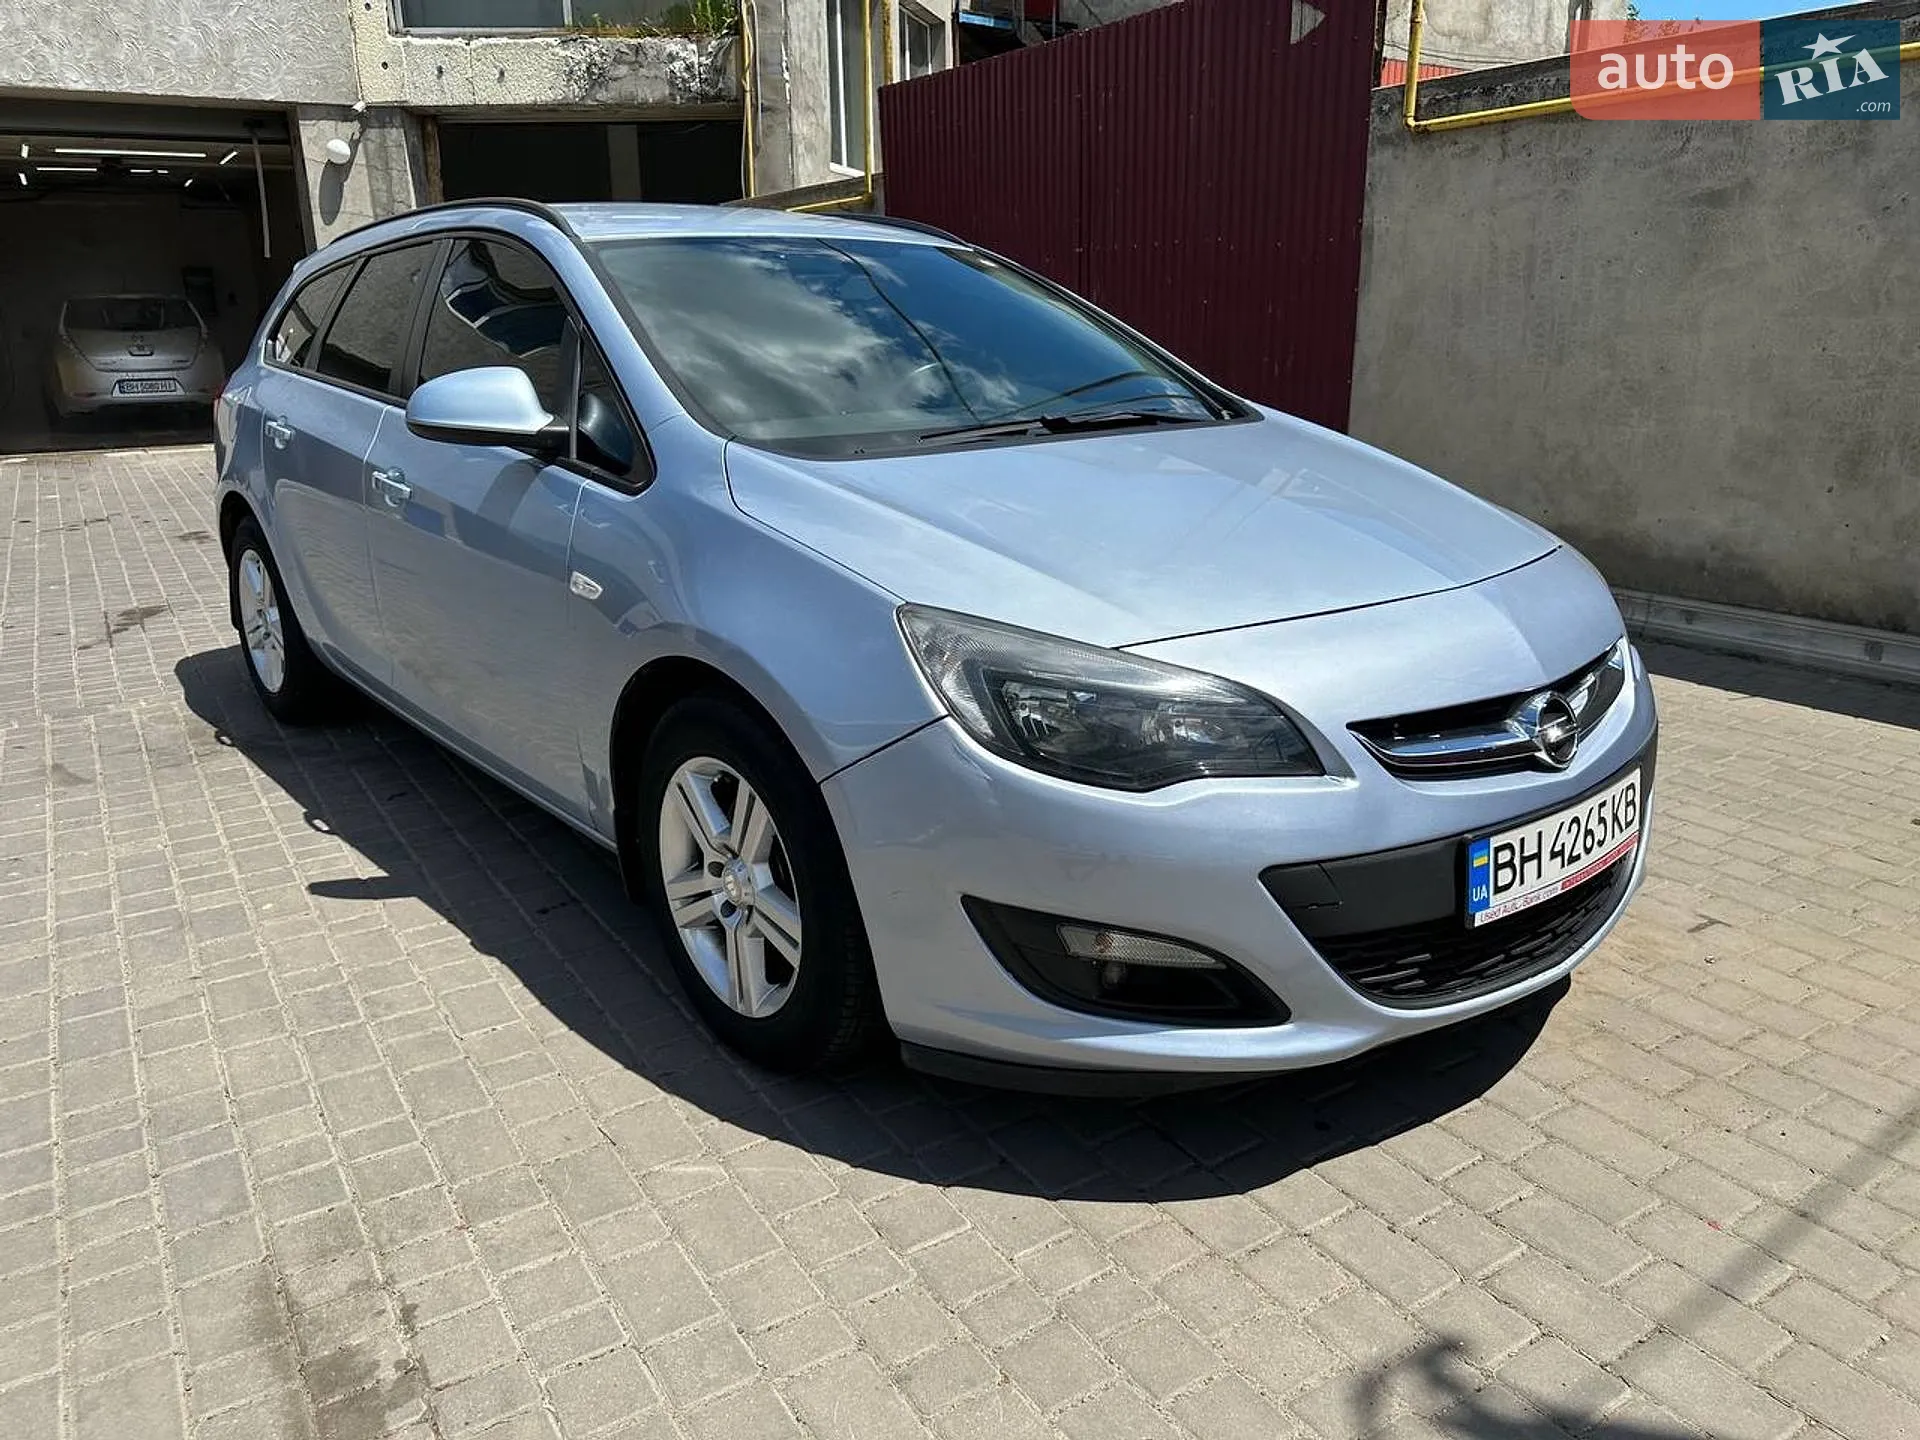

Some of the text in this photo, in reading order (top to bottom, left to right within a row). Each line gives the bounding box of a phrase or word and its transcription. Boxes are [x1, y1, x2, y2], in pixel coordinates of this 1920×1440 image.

[1493, 830, 1543, 896] BH
[1549, 799, 1608, 869] 4265
[1612, 781, 1637, 840] KB
[1472, 884, 1488, 902] UA
